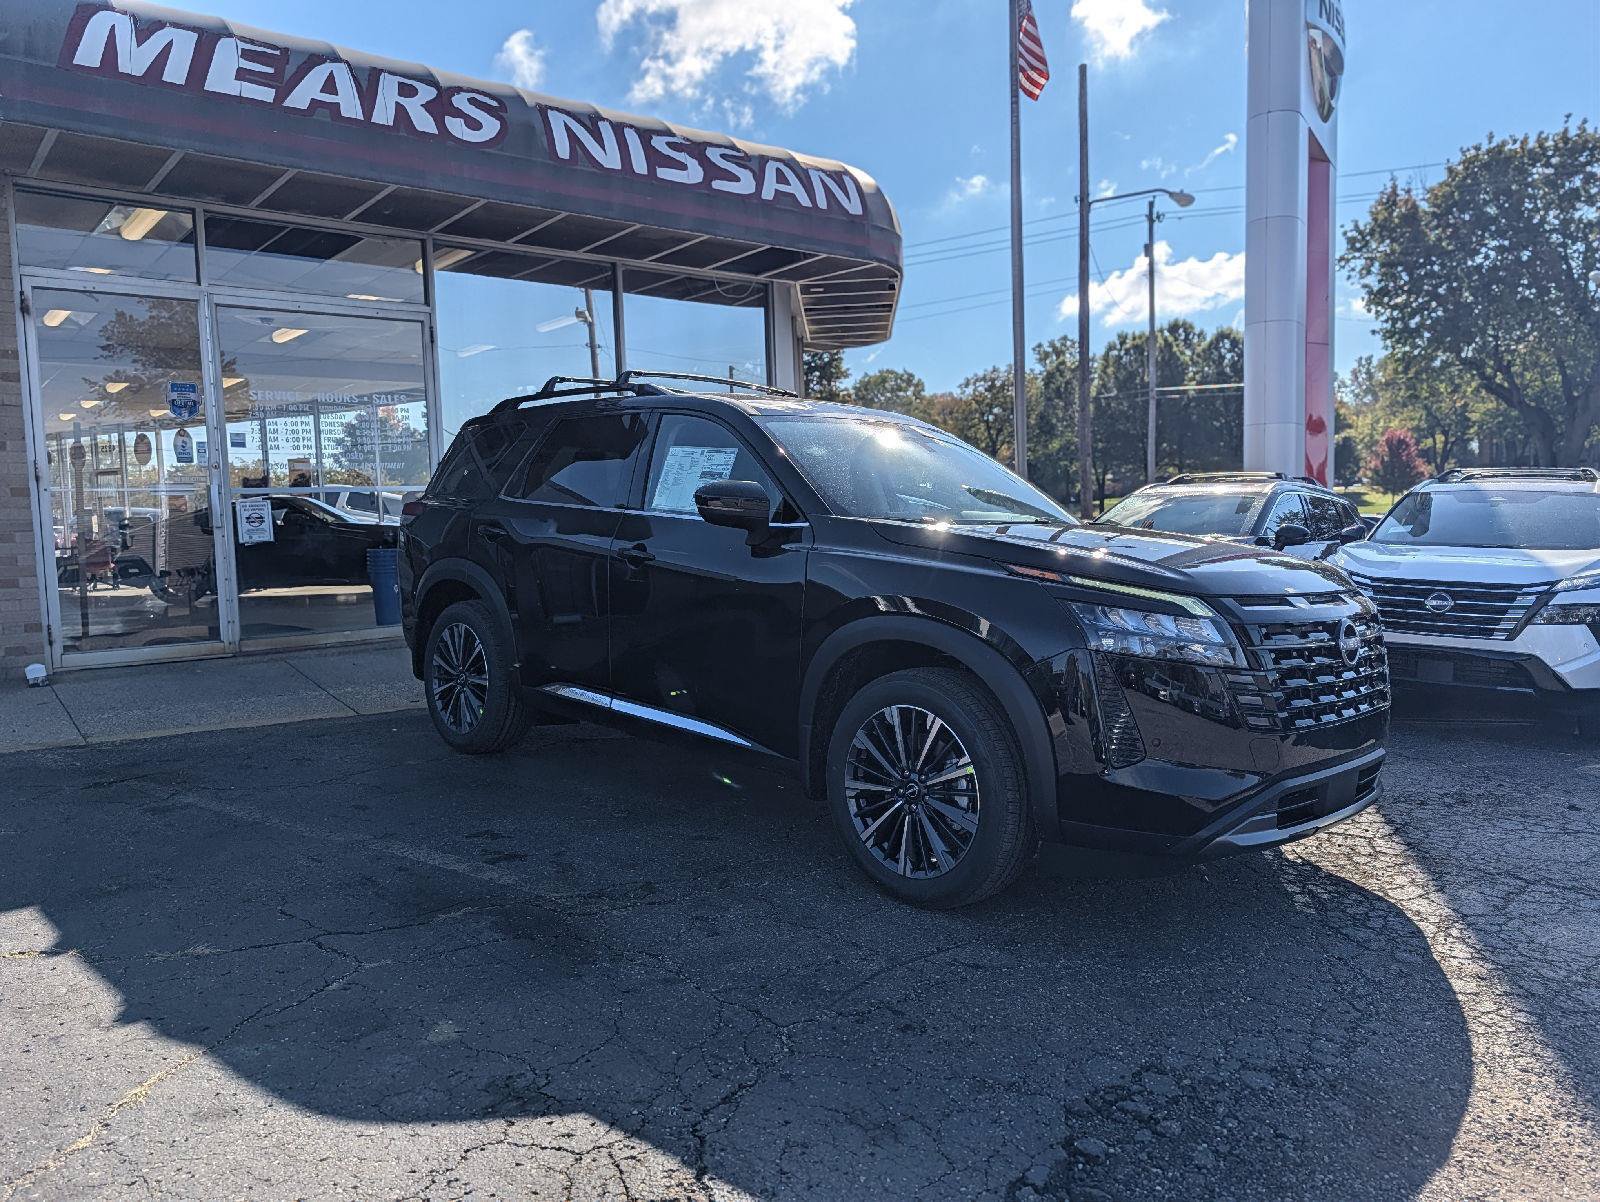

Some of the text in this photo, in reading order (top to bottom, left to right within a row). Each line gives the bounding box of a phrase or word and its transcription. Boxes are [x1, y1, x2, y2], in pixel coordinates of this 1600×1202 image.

[73, 10, 863, 216] MEARS NISSAN
[249, 390, 407, 405] SERVICE HOURS SALES
[300, 420, 311, 428] PM
[284, 428, 300, 436] 7:00
[361, 461, 405, 470] APPONTMENT
